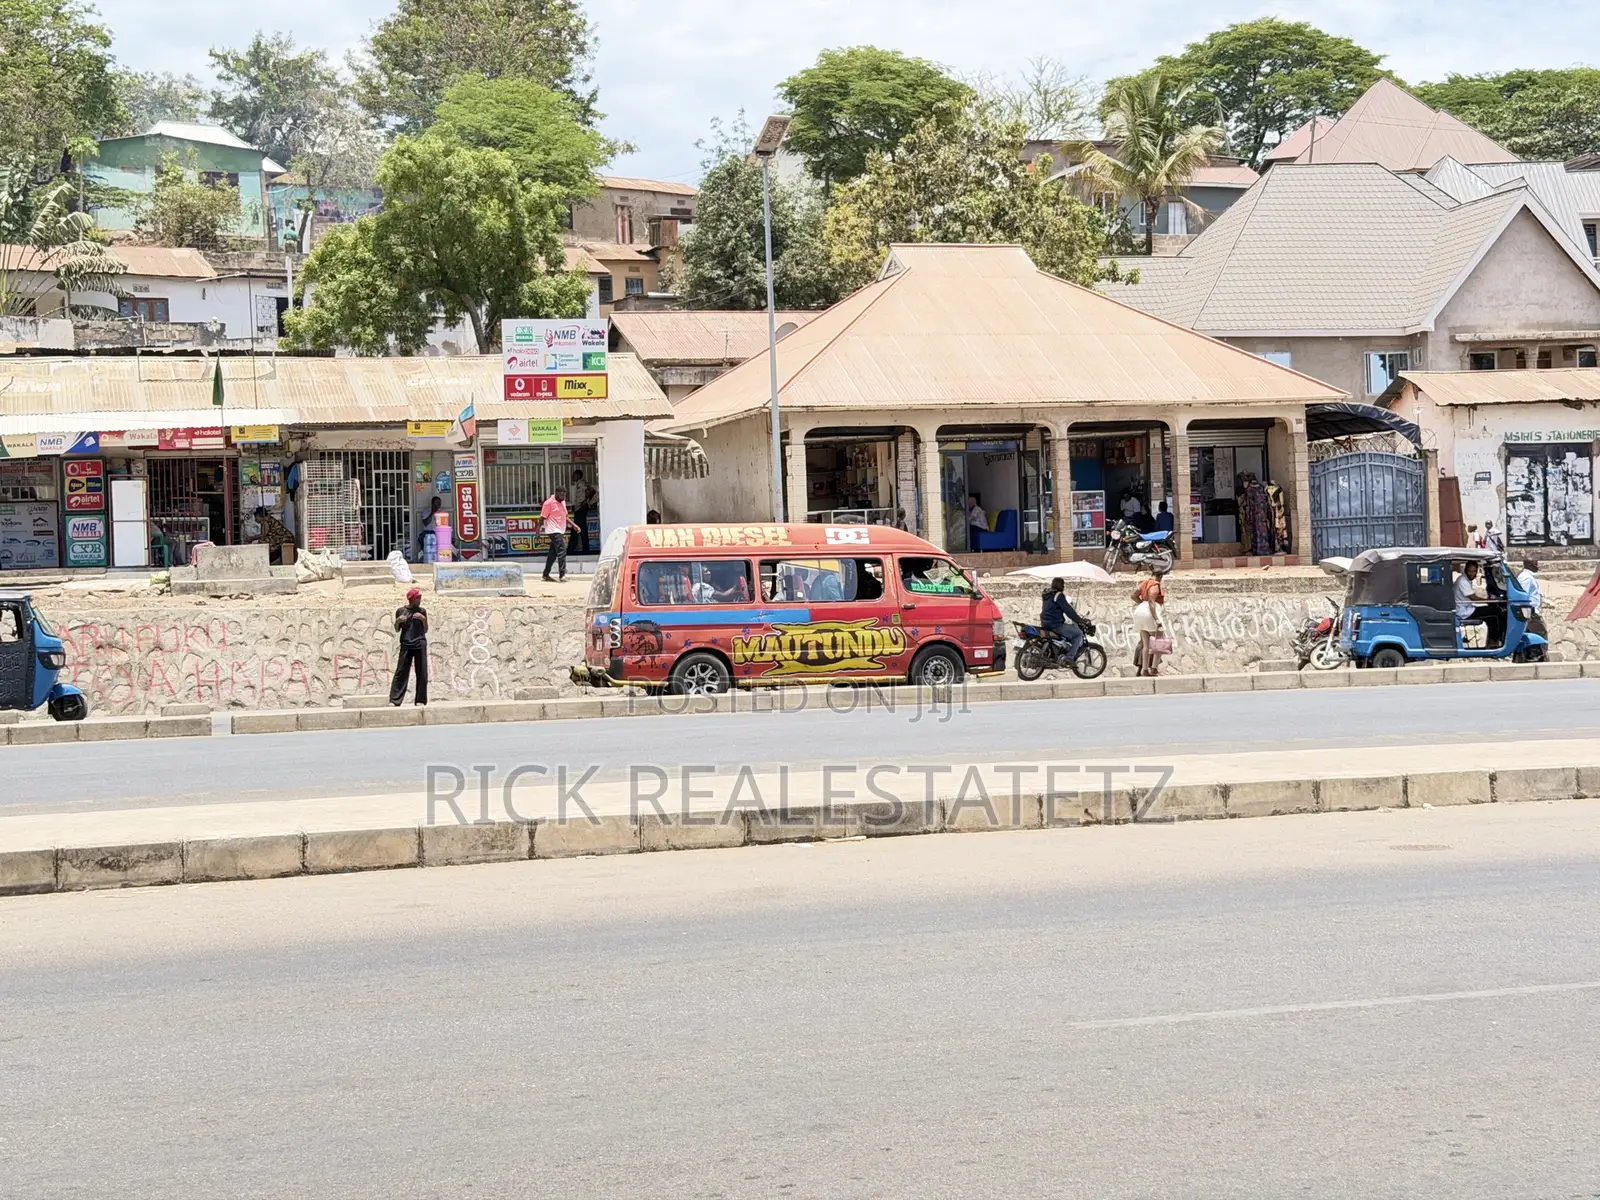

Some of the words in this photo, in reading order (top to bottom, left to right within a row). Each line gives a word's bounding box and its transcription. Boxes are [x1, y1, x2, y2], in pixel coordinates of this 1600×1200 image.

[554, 330, 577, 340] NMB
[591, 357, 605, 366] KCB
[564, 380, 587, 390] Mixx
[40, 438, 63, 446] NMB
[462, 486, 477, 535] m-pesa
[72, 523, 97, 532] NMB
[646, 528, 695, 547] VAN
[701, 528, 792, 546] DIESEL
